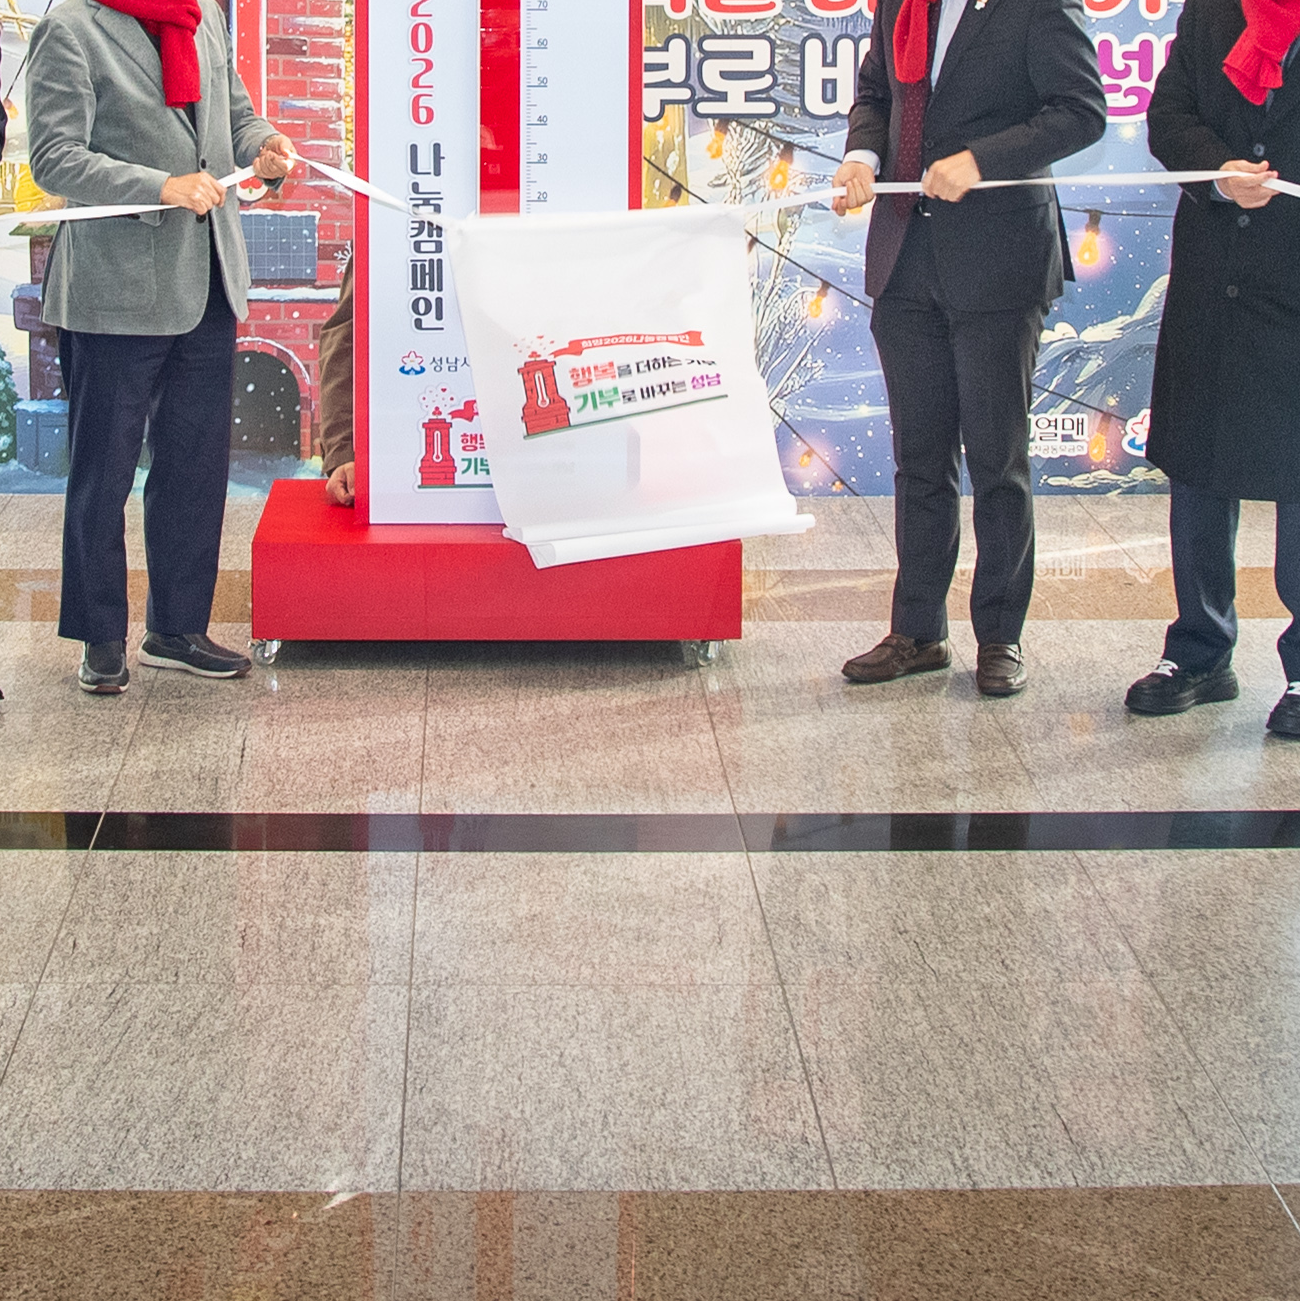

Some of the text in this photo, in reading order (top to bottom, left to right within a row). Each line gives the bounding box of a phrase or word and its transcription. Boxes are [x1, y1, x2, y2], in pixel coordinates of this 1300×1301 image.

[537, 0, 548, 8] 70
[537, 38, 548, 47] 60
[537, 76, 548, 86] 50
[537, 115, 548, 124] 40
[537, 153, 548, 162] 30
[537, 192, 548, 200] 20
[574, 373, 721, 413] 기부로 바꾸는 성남
